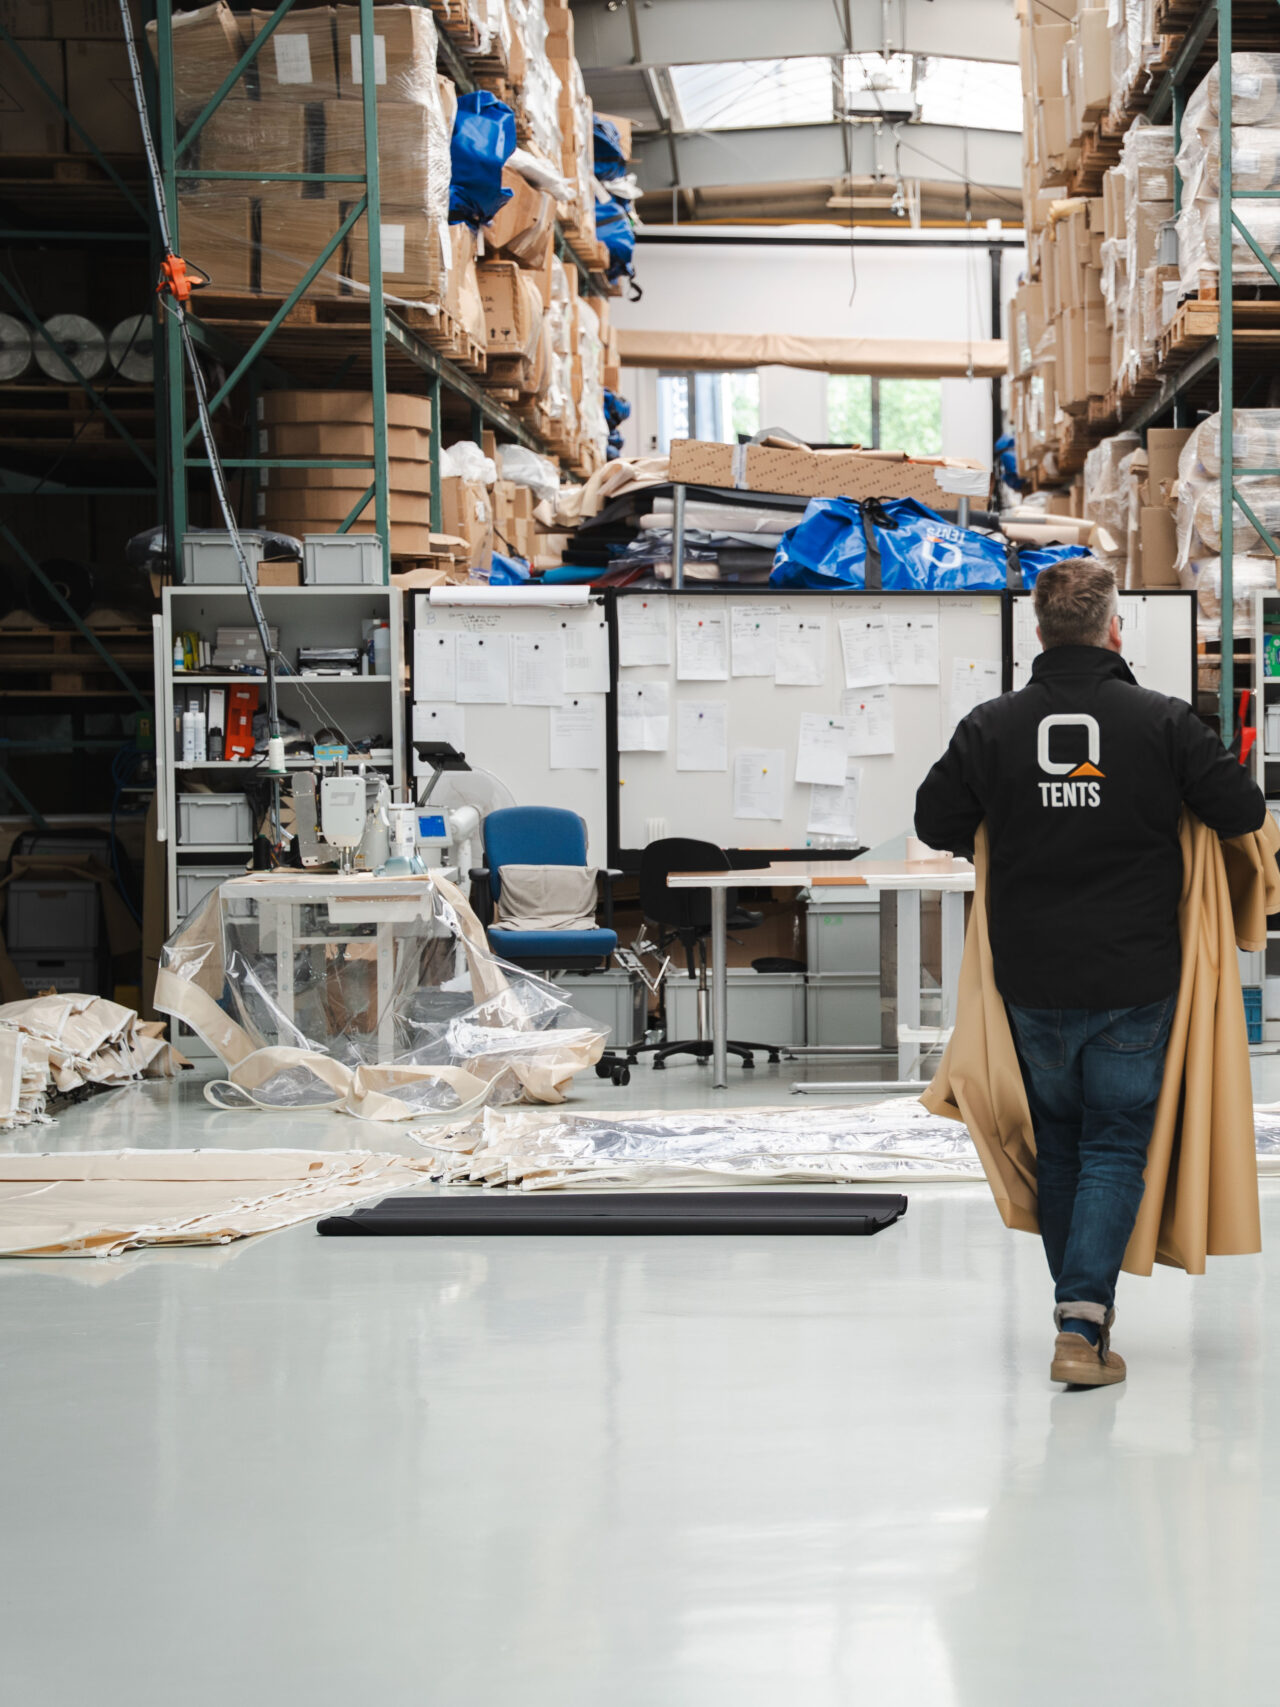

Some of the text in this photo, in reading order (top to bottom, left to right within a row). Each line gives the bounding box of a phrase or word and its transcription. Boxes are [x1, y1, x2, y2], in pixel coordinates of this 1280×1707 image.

[927, 527, 966, 545] TENTS
[1037, 713, 1106, 778] Q
[1038, 782, 1101, 808] TENTS
